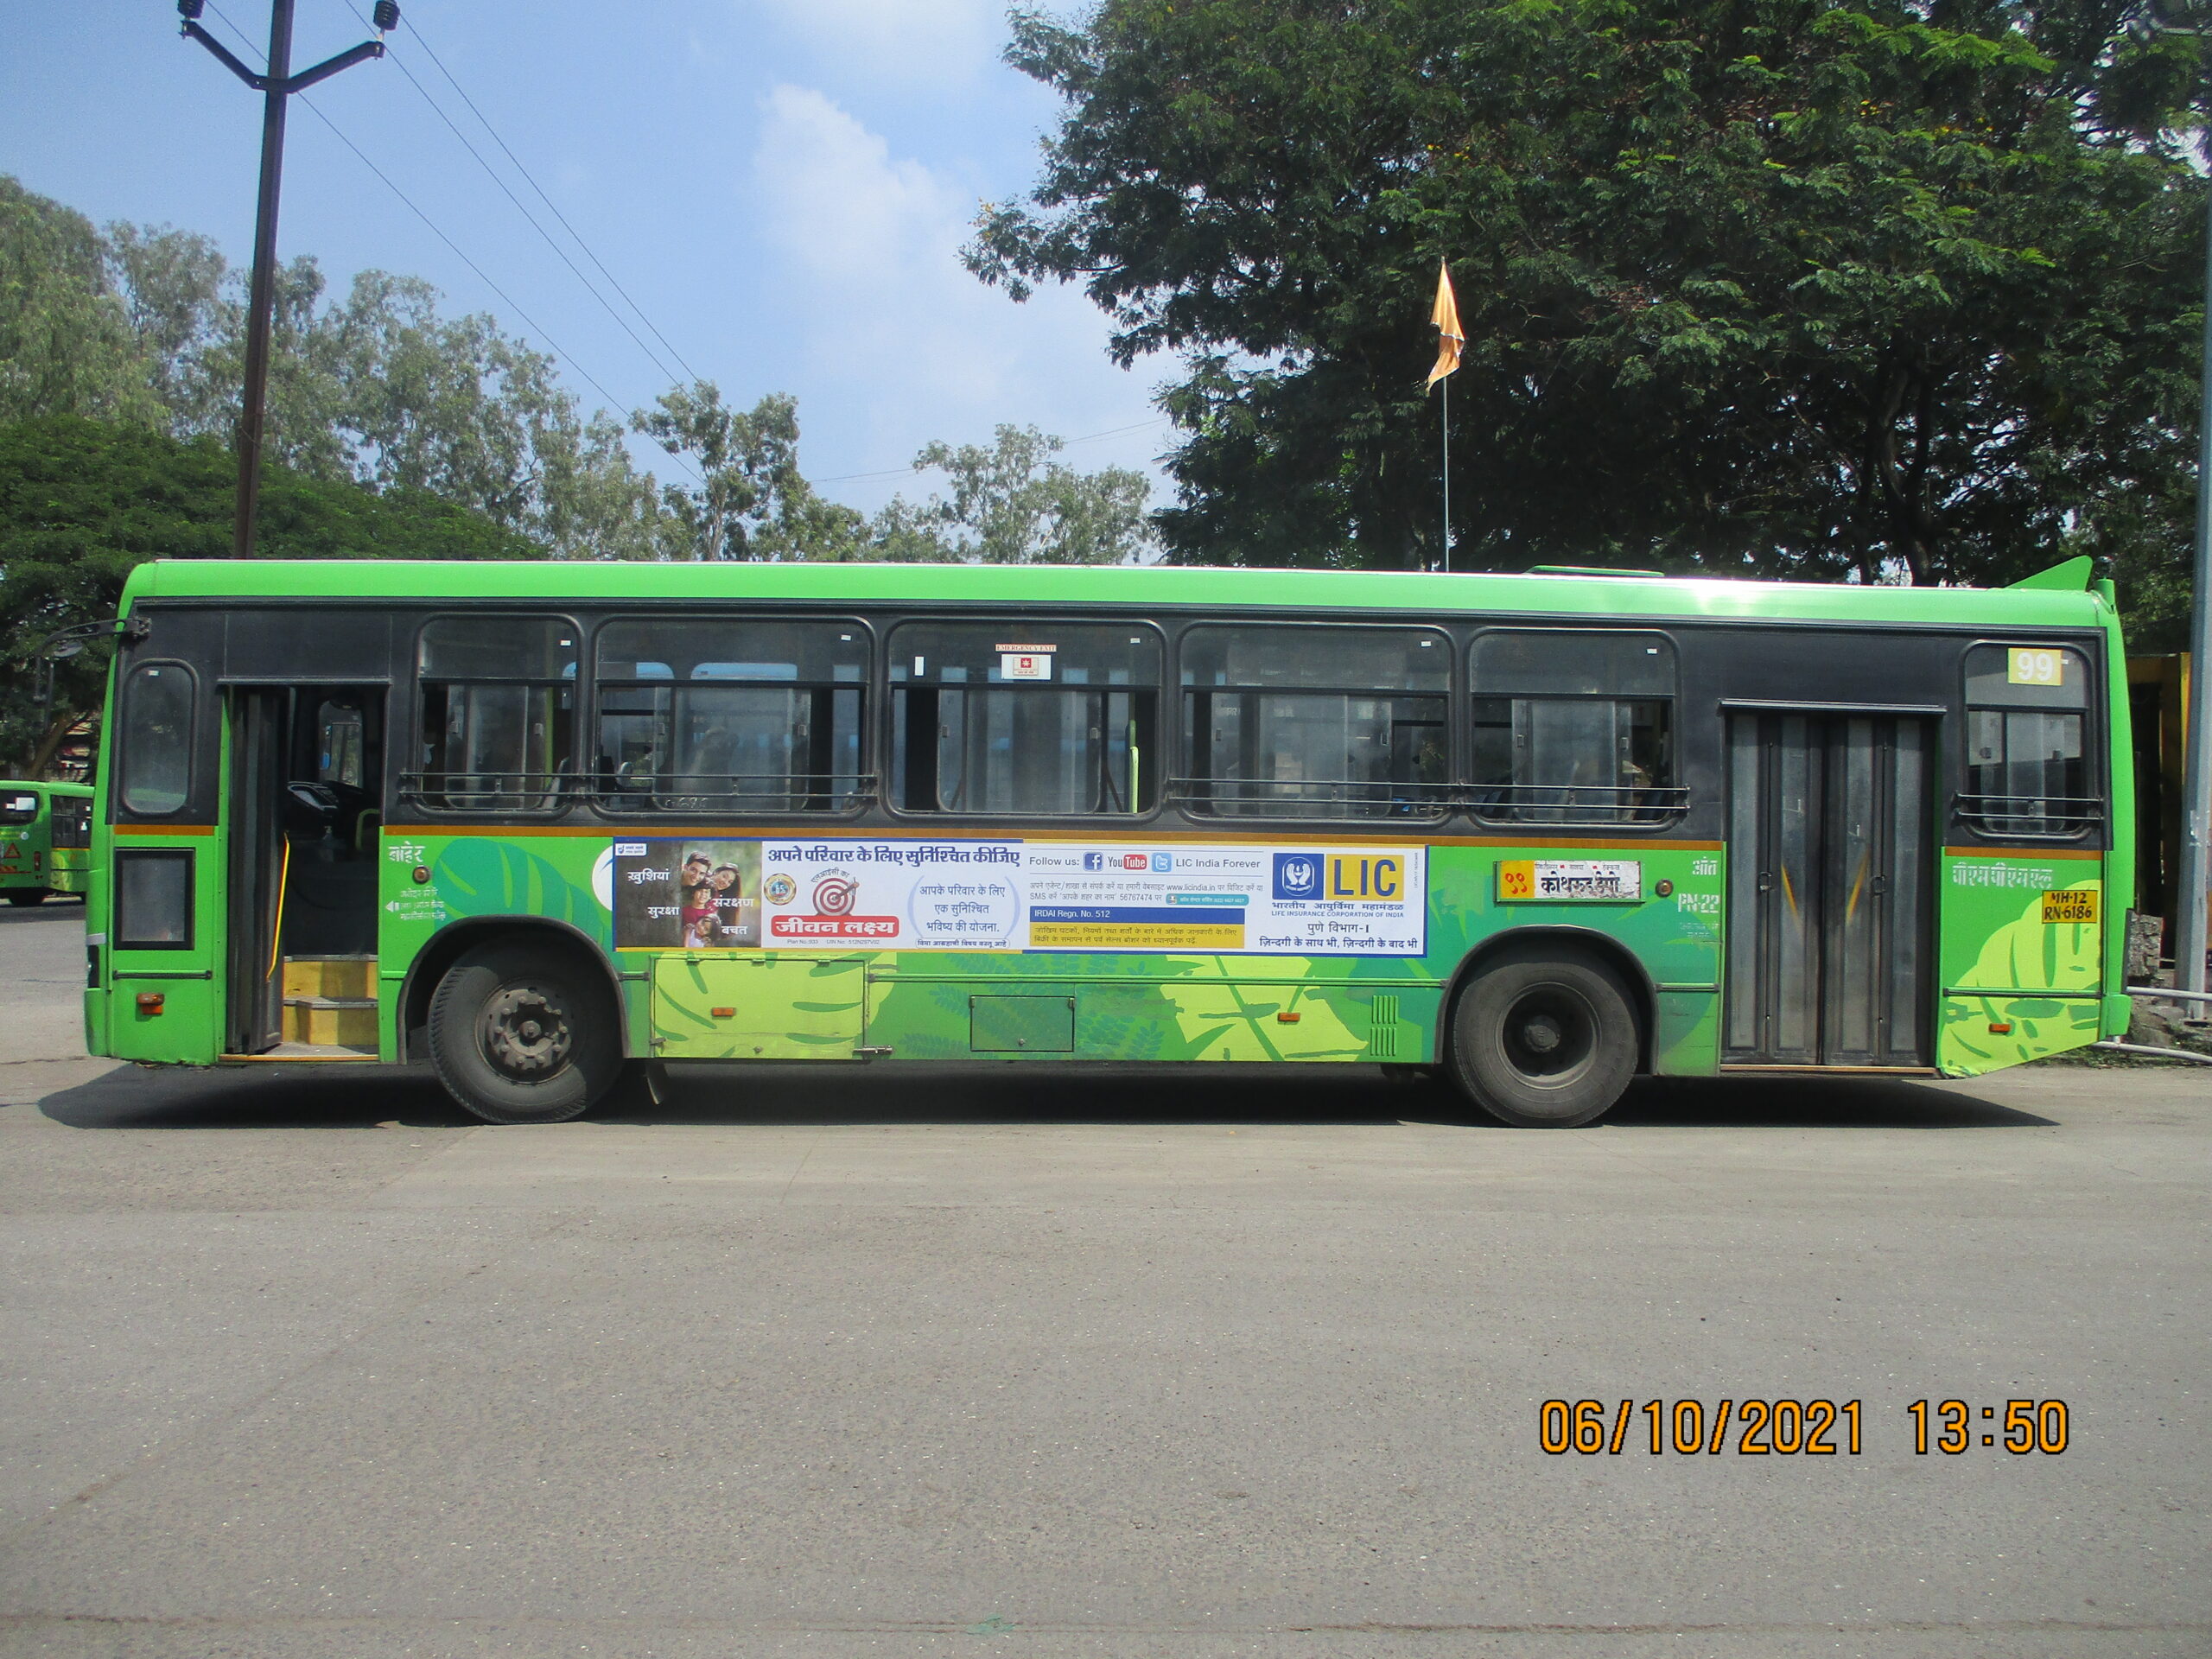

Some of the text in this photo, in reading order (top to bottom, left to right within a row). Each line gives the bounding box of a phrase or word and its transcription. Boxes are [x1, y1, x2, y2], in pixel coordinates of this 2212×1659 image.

[2018, 652, 2053, 682] 99
[768, 845, 1020, 868] अपने परिवार के लिए सुनिश्चित कीजिए
[1029, 856, 1062, 866] Follow
[1176, 858, 1193, 868] LIC
[1196, 858, 1220, 868] India
[1223, 859, 1261, 868] Forever
[1334, 859, 1396, 896] LIC
[919, 883, 1006, 897] आपके परिवार के लिए
[1126, 881, 1141, 891] हमारी
[1166, 883, 1216, 892] www.licindia.in
[712, 894, 754, 907] संरक्षण
[1272, 900, 1404, 912] भारतीय आयुर्विमा महामंडळ
[648, 906, 680, 918] सुरक्षा
[934, 901, 990, 917] एक सुनिश्चित
[1057, 910, 1078, 918] Regn.
[721, 925, 748, 935] बचत
[775, 917, 895, 935] जीवन लक्ष्य
[926, 919, 1000, 932] भविष्य की योजना.
[1307, 921, 1324, 935] पुणे
[1294, 936, 1303, 948] के
[1306, 938, 1324, 948] साथ
[1326, 936, 1339, 949] भी,
[1377, 937, 1386, 948] के
[1389, 938, 1404, 949] बाद
[1407, 937, 1418, 949] भी
